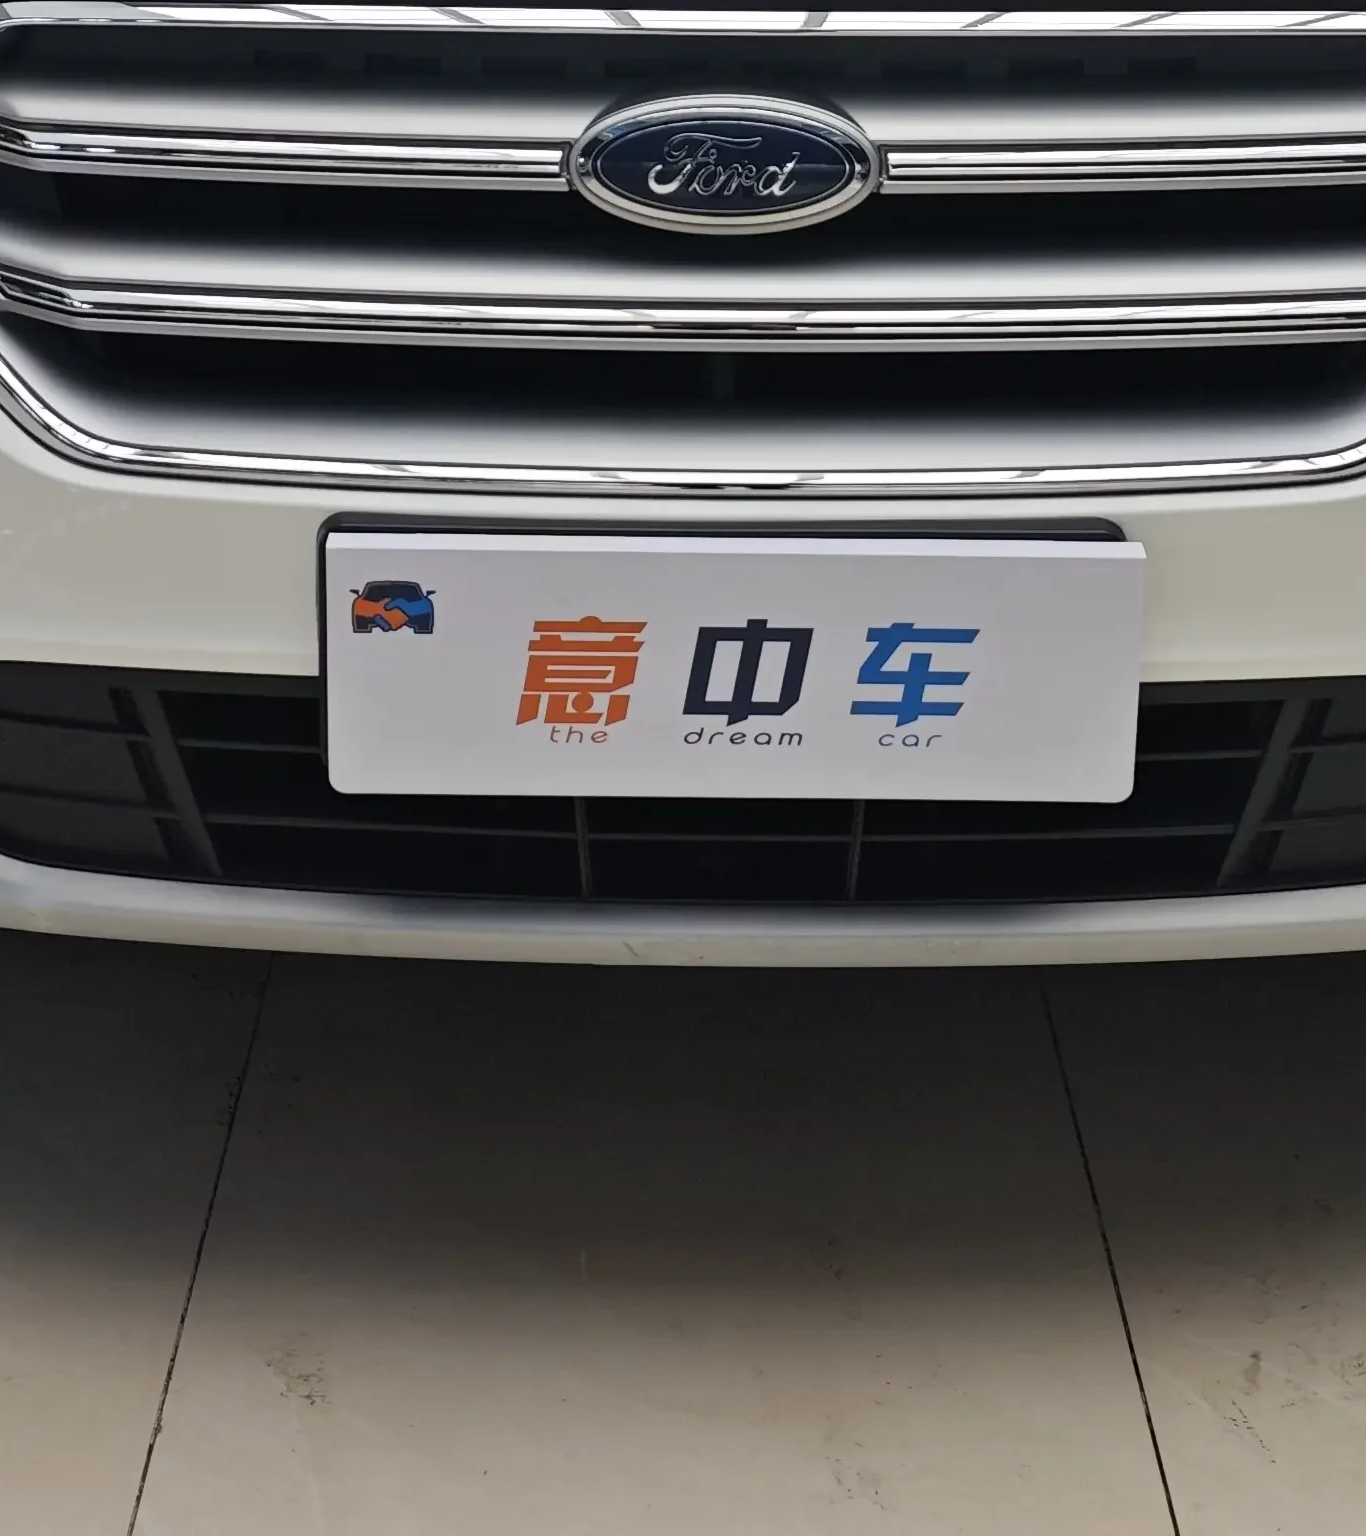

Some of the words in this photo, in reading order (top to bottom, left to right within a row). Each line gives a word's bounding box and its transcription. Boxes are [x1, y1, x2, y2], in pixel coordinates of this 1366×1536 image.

[647, 132, 800, 197] Ford
[516, 615, 981, 729] 意中车
[550, 726, 609, 745] the
[684, 728, 803, 747] dream
[878, 731, 943, 748] car
